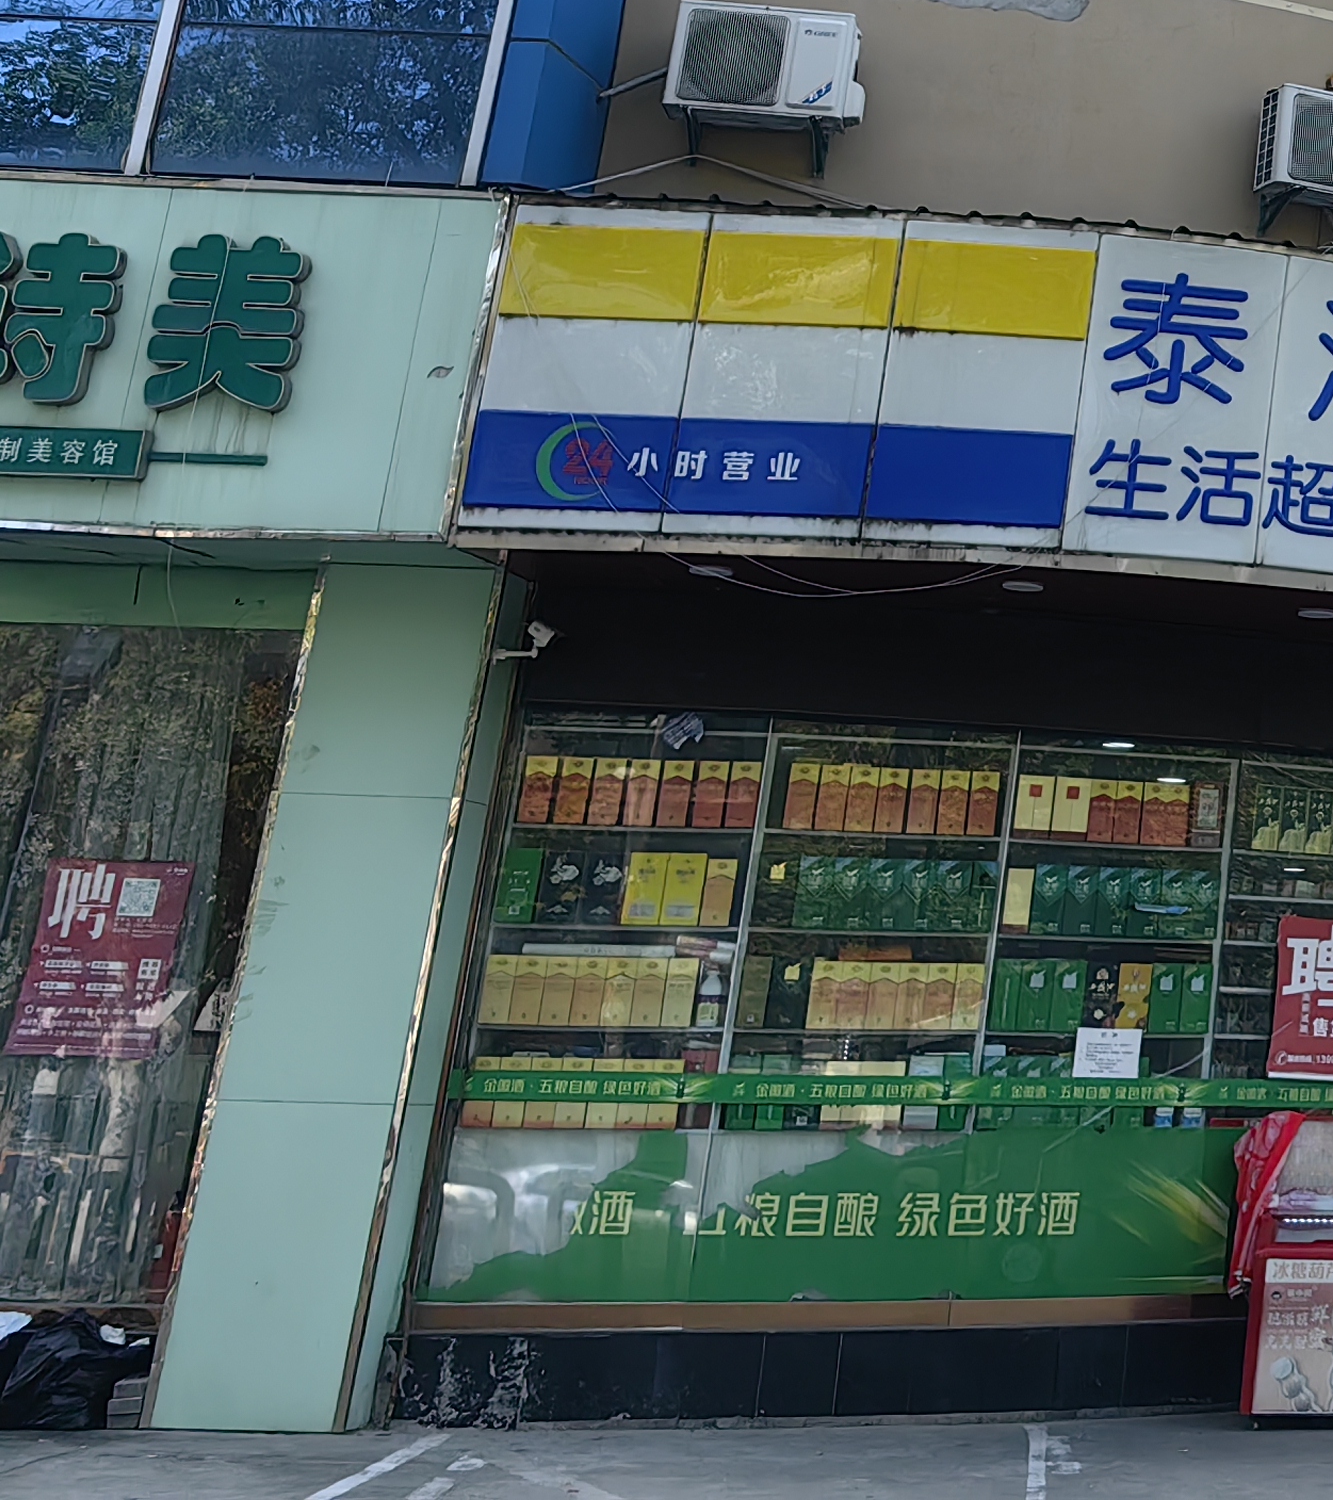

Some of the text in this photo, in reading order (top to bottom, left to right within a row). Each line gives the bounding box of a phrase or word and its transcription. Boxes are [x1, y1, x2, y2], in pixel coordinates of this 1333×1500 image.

[627, 447, 801, 481] 小时营业
[48, 863, 116, 940] 聘
[896, 1191, 1081, 1237] 绿色好酒
